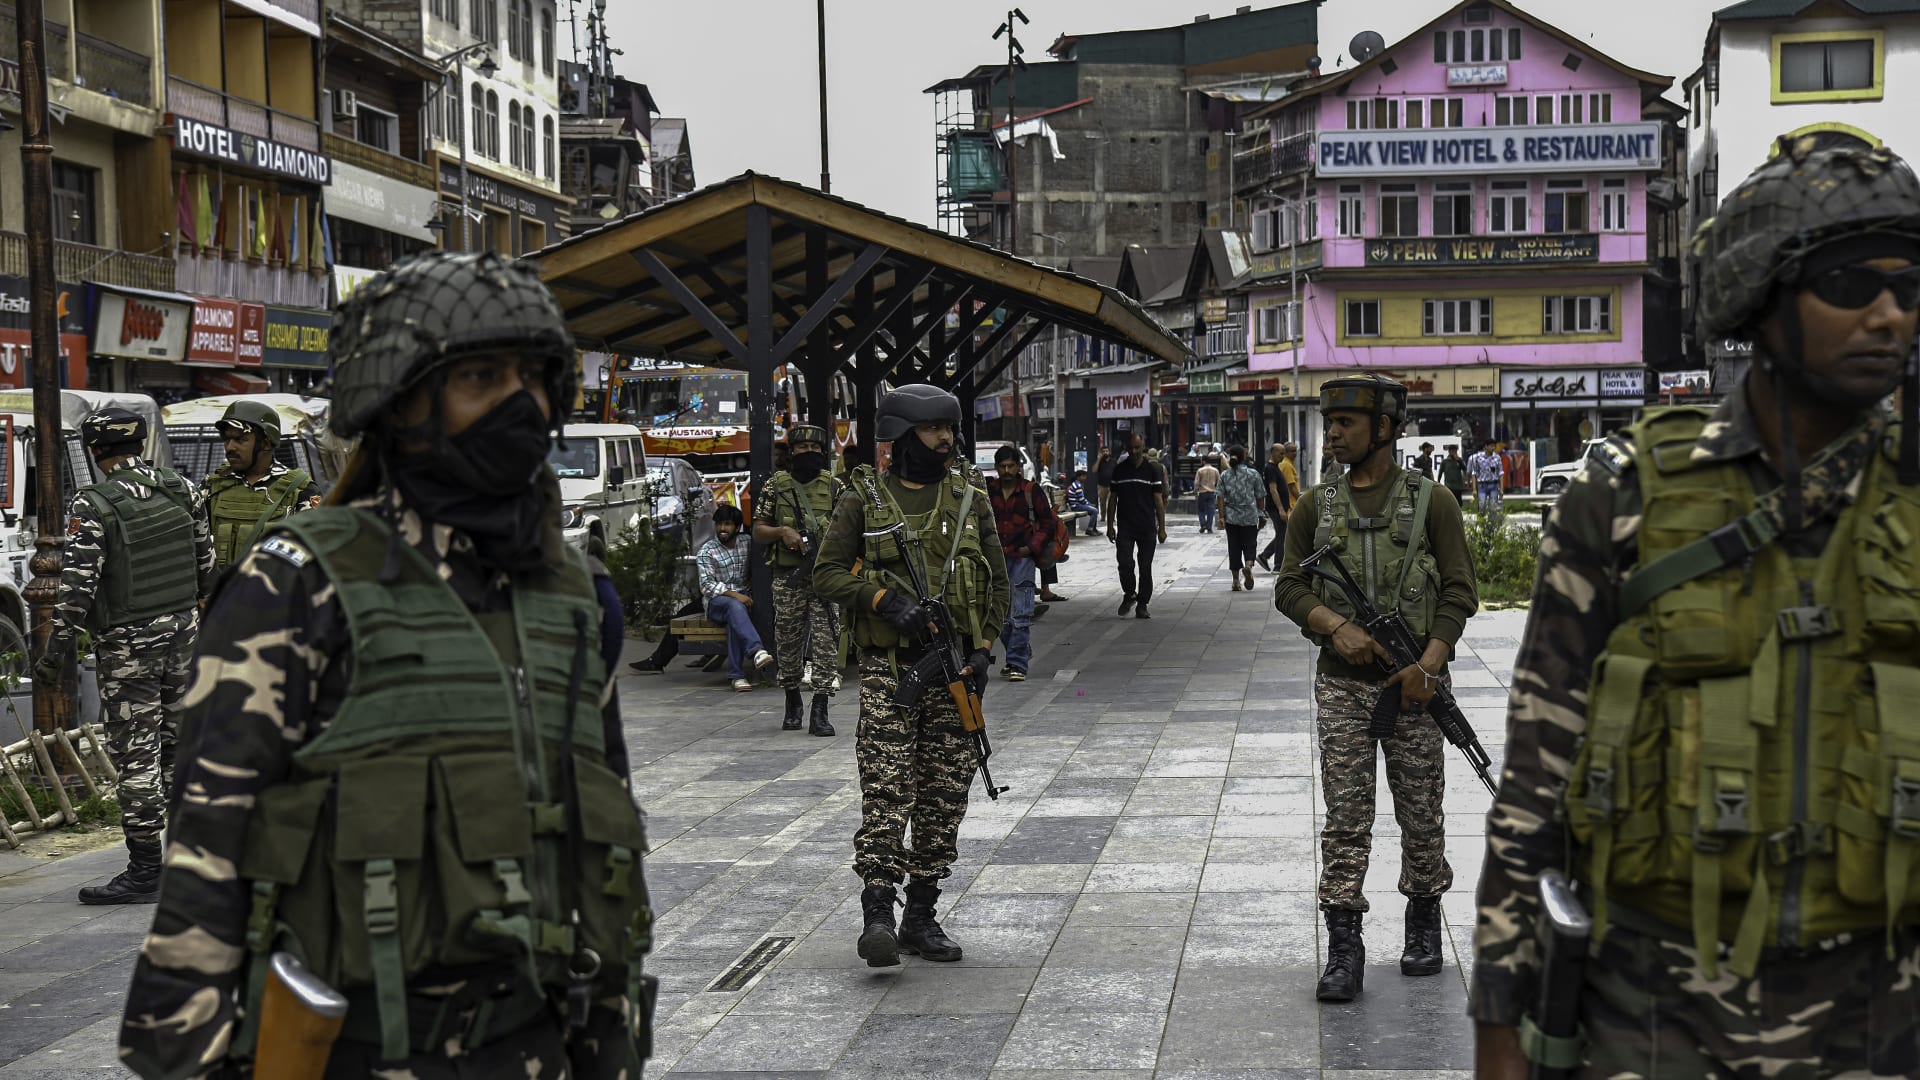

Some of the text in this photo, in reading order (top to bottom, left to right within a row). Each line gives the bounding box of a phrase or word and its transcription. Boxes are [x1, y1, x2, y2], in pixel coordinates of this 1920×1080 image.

[178, 119, 328, 182] HOTEL DIAMOND
[1320, 133, 1655, 167] PEAK VIEW HOTEL & RESTAURANT
[1393, 240, 1495, 261] PEAK VIEW
[1518, 239, 1563, 248] HOTEL
[1501, 247, 1592, 259] RESTAURANT
[195, 306, 234, 328] DIAMOND
[192, 331, 235, 353] APPARELS
[243, 329, 259, 342] HOTEL
[266, 322, 328, 353] KASHMIR DREAMS
[240, 344, 261, 357] DIAMOND
[1602, 370, 1642, 379] PEAK VIEW
[1606, 380, 1637, 388] HOTEL &
[1096, 394, 1146, 411] IGHTWAY
[669, 428, 714, 437] MUSTANG
